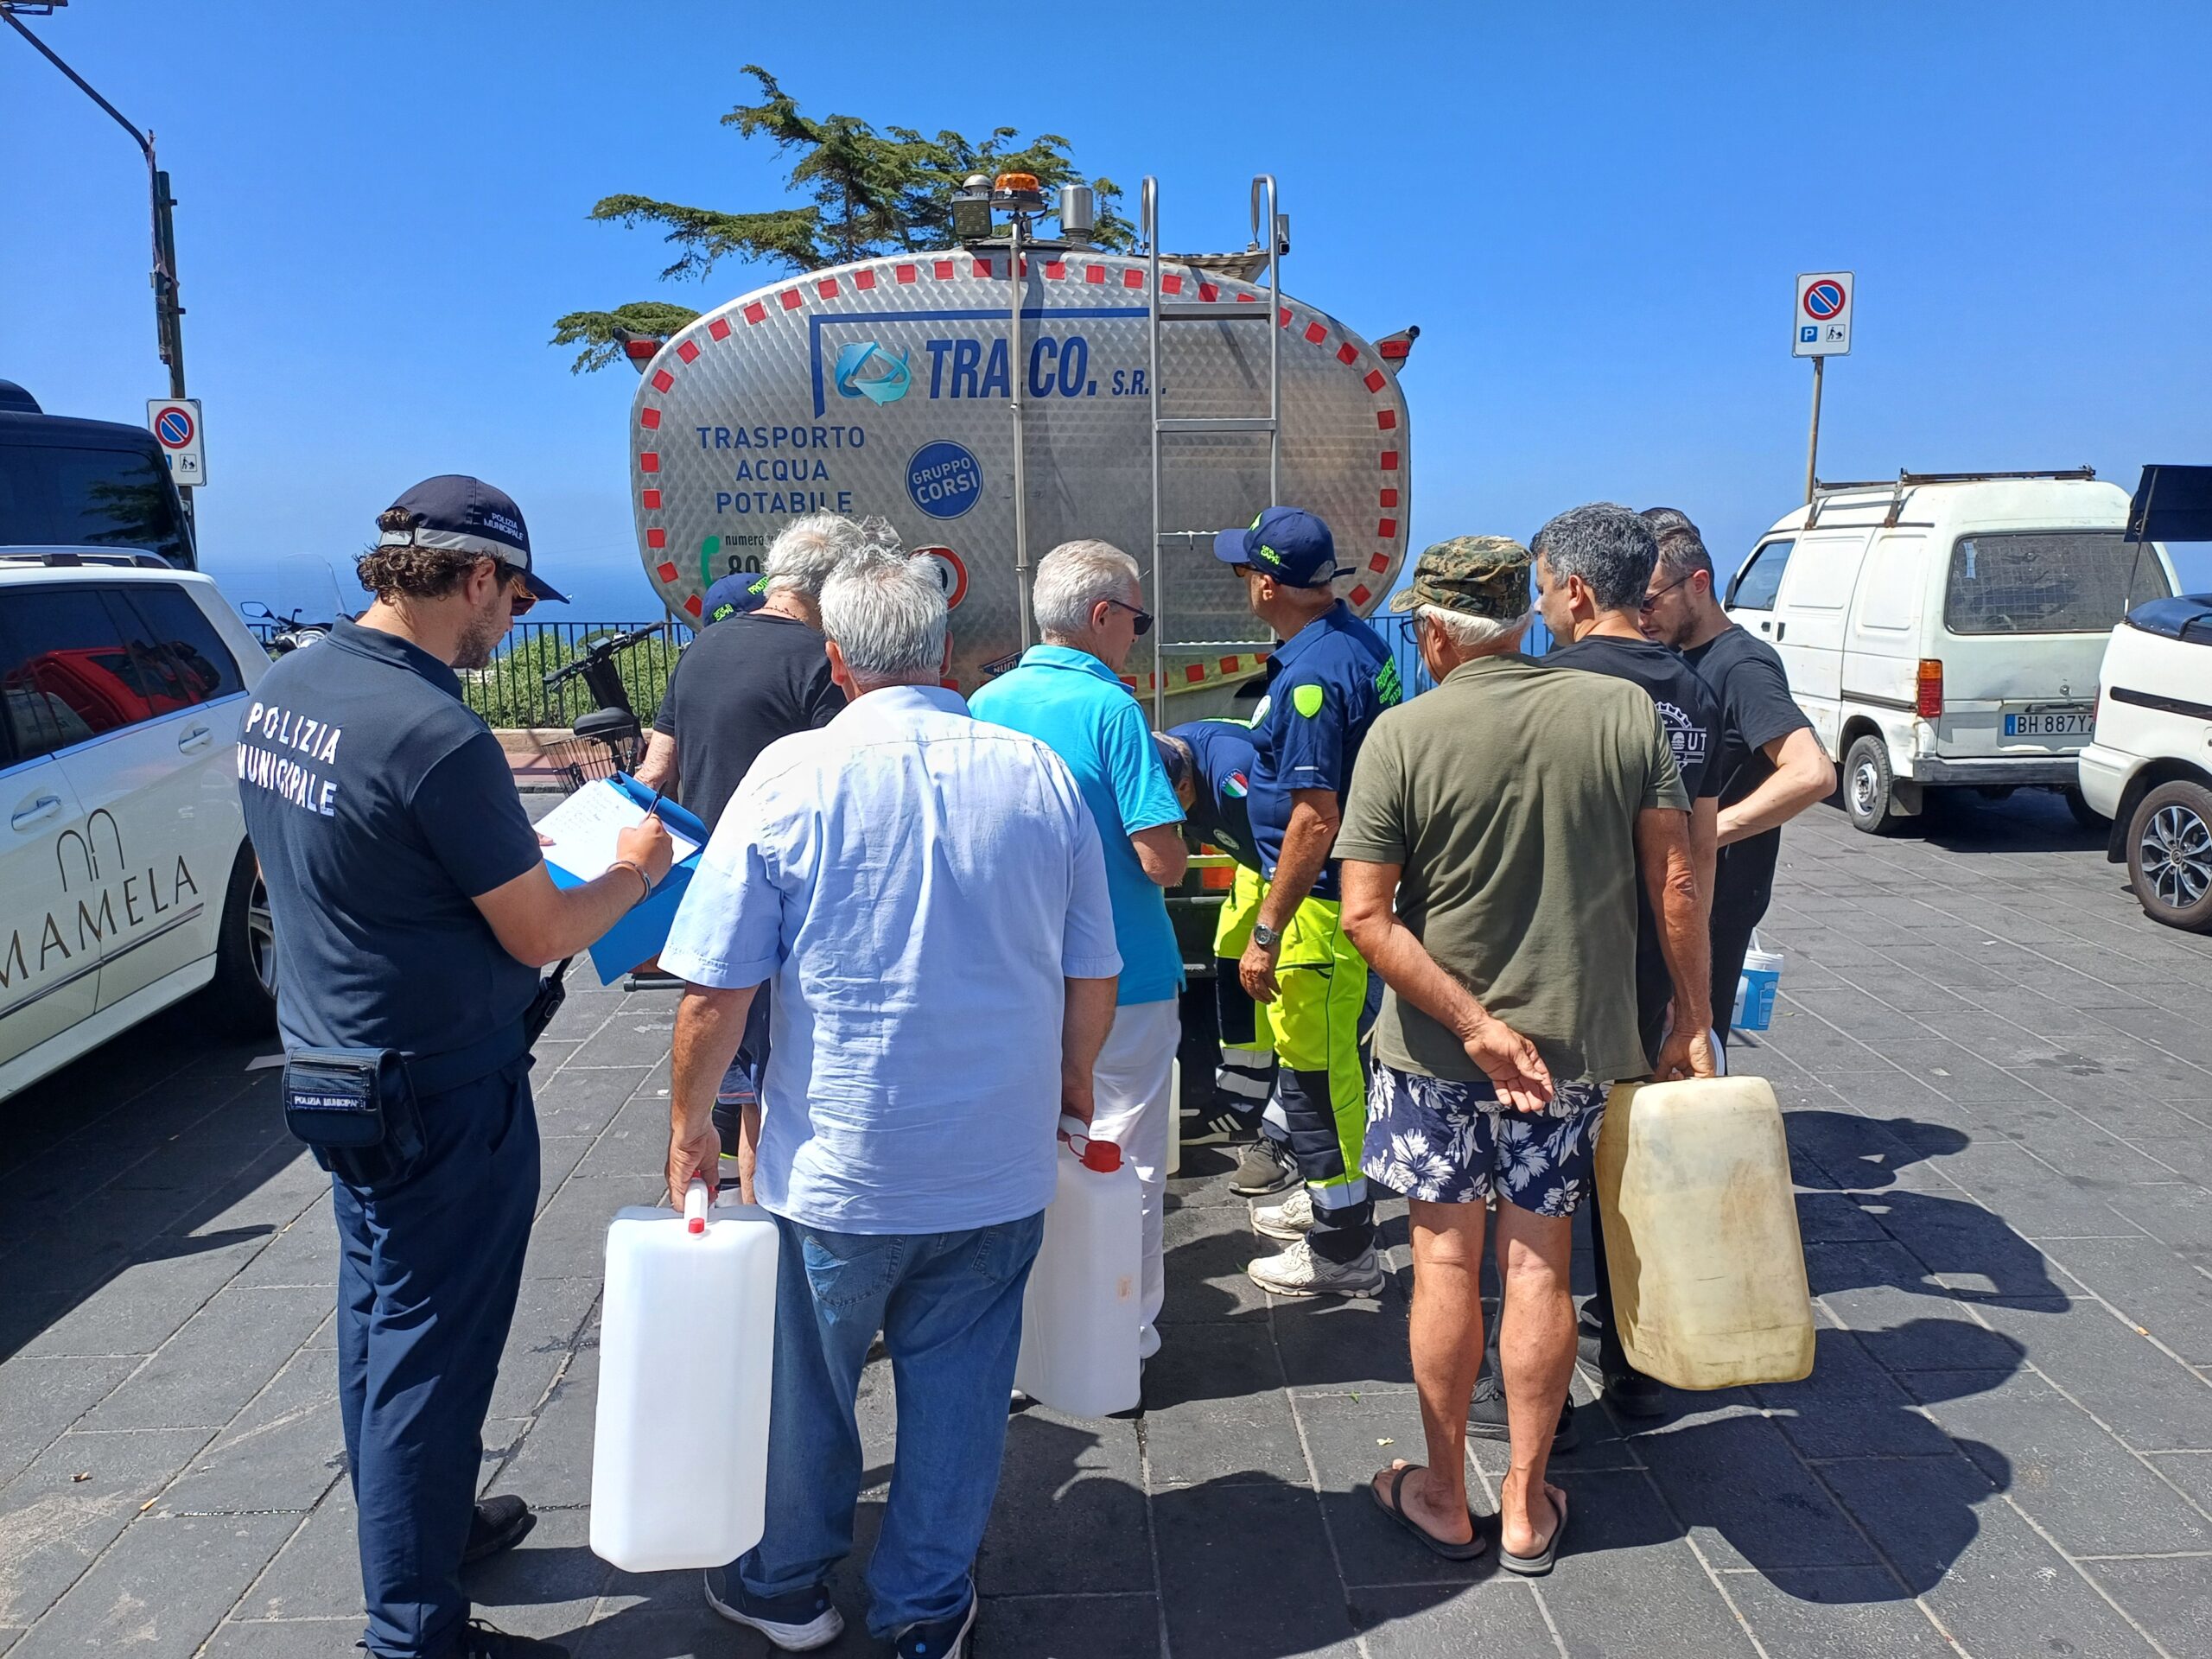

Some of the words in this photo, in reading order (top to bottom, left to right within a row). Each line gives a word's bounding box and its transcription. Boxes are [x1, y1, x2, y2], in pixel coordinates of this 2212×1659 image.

[925, 336, 1097, 399] TRACO.
[1111, 370, 1166, 396] S.R..
[696, 426, 865, 448] TRASPORTO
[735, 460, 830, 481] ACQUA
[912, 457, 971, 484] GRUPPO
[917, 471, 978, 504] CORSI
[716, 491, 854, 513] POTABILE
[483, 518, 524, 541] MUNICIPALE
[491, 512, 518, 530] POLIZIA
[725, 535, 764, 546] numero
[245, 702, 341, 765] POLIZIA
[2018, 715, 2038, 733] BH
[236, 741, 338, 817] MUNICIPALE
[0, 855, 199, 988] MAMELA
[295, 1096, 321, 1105] POLIZIA
